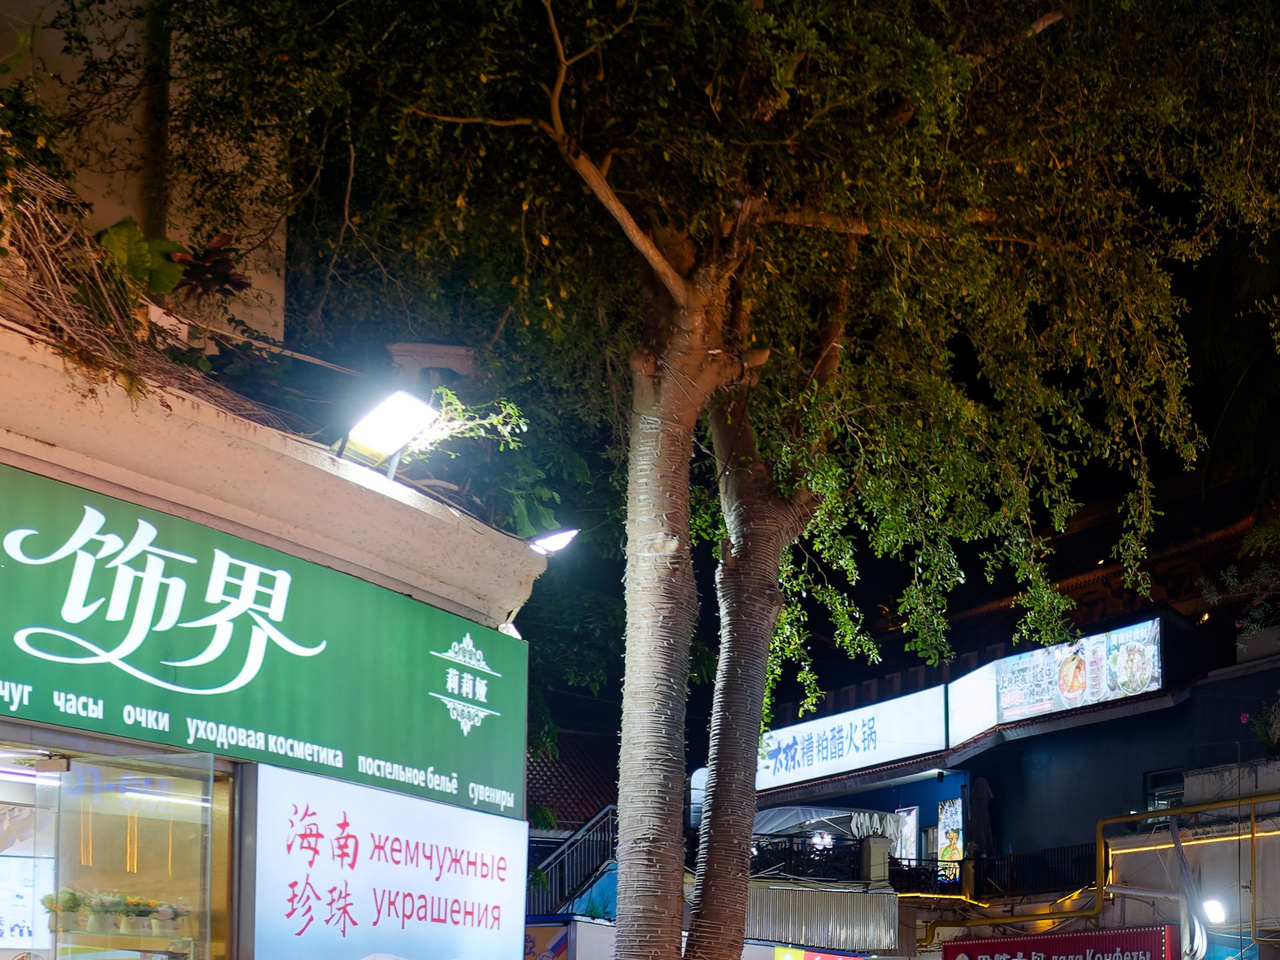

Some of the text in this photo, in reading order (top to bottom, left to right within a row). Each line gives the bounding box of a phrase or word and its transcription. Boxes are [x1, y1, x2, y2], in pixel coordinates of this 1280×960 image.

[3, 505, 327, 695] 饰界
[53, 690, 104, 719] часы
[123, 704, 170, 732] очки
[187, 717, 266, 750] уходовая
[268, 733, 344, 768] косметика
[358, 755, 426, 786] постельное
[427, 766, 458, 794] бельё
[468, 782, 515, 811] сувениры
[286, 802, 359, 870] 海南
[369, 832, 507, 882] жемчужные
[285, 873, 358, 938] 珍珠
[372, 888, 501, 930] украшения
